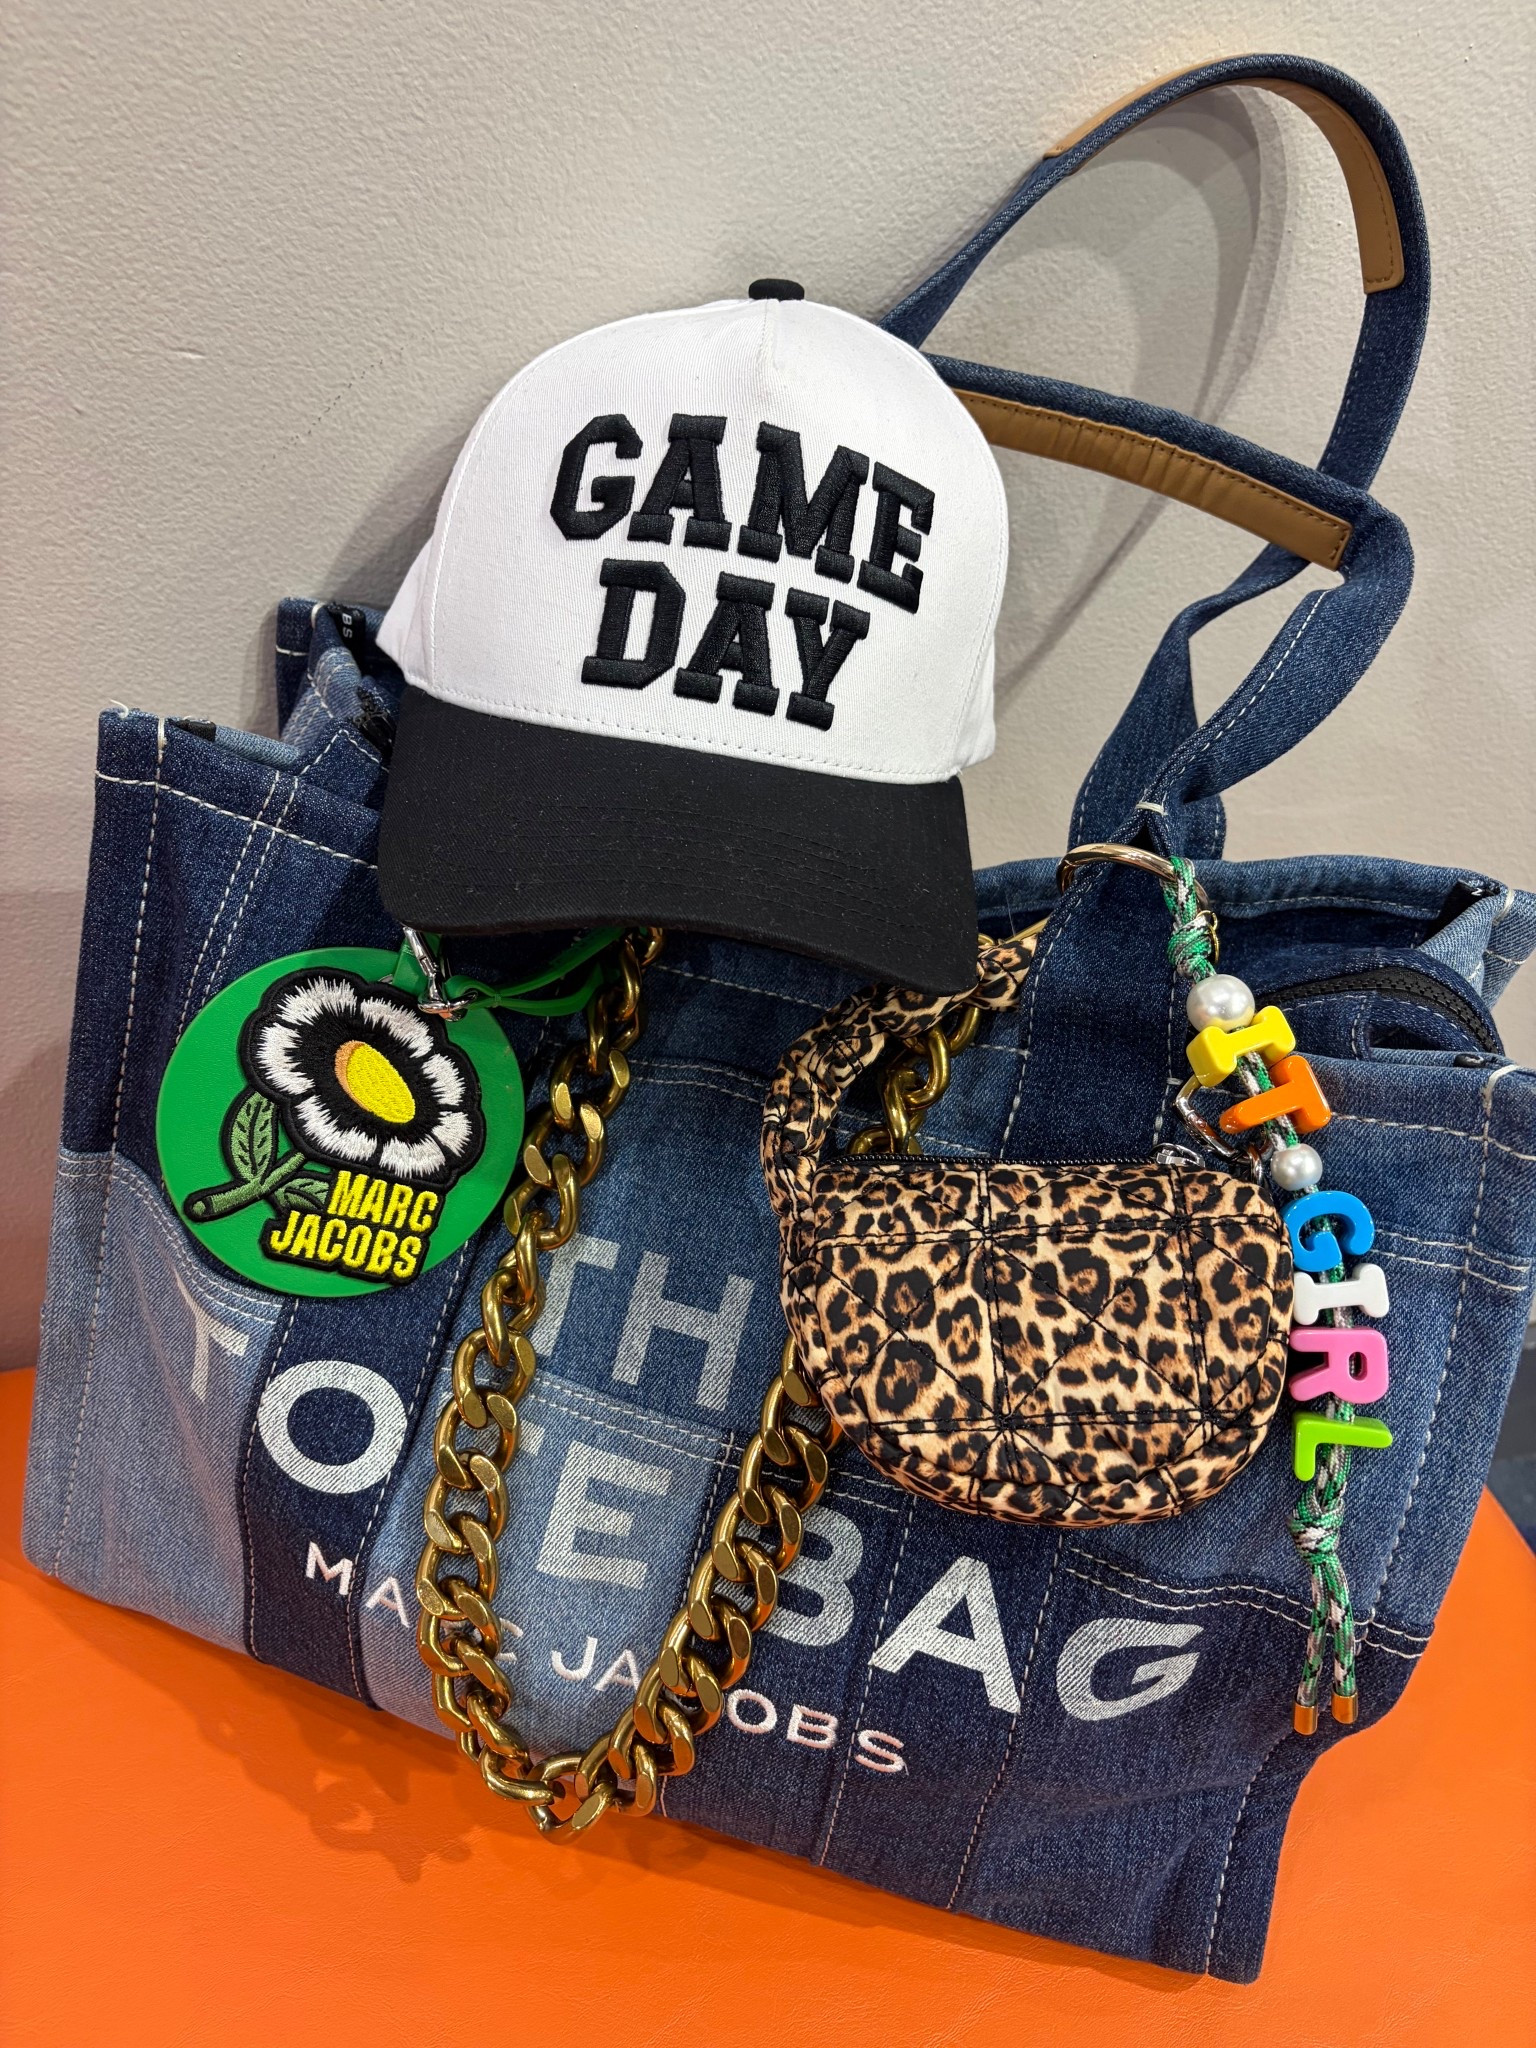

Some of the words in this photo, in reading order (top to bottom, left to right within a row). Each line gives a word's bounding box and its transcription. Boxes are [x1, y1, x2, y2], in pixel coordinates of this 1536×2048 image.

[550, 413, 936, 615] GAME
[581, 558, 871, 732] DAY
[1186, 1005, 1331, 1135] IT
[270, 1210, 422, 1279] JACOBS
[327, 1170, 439, 1233] MARC
[529, 1232, 829, 1435] TH
[1284, 1191, 1393, 1482] GIRL
[714, 1503, 1204, 1721] BAG
[551, 1636, 906, 1773] JAOBS
